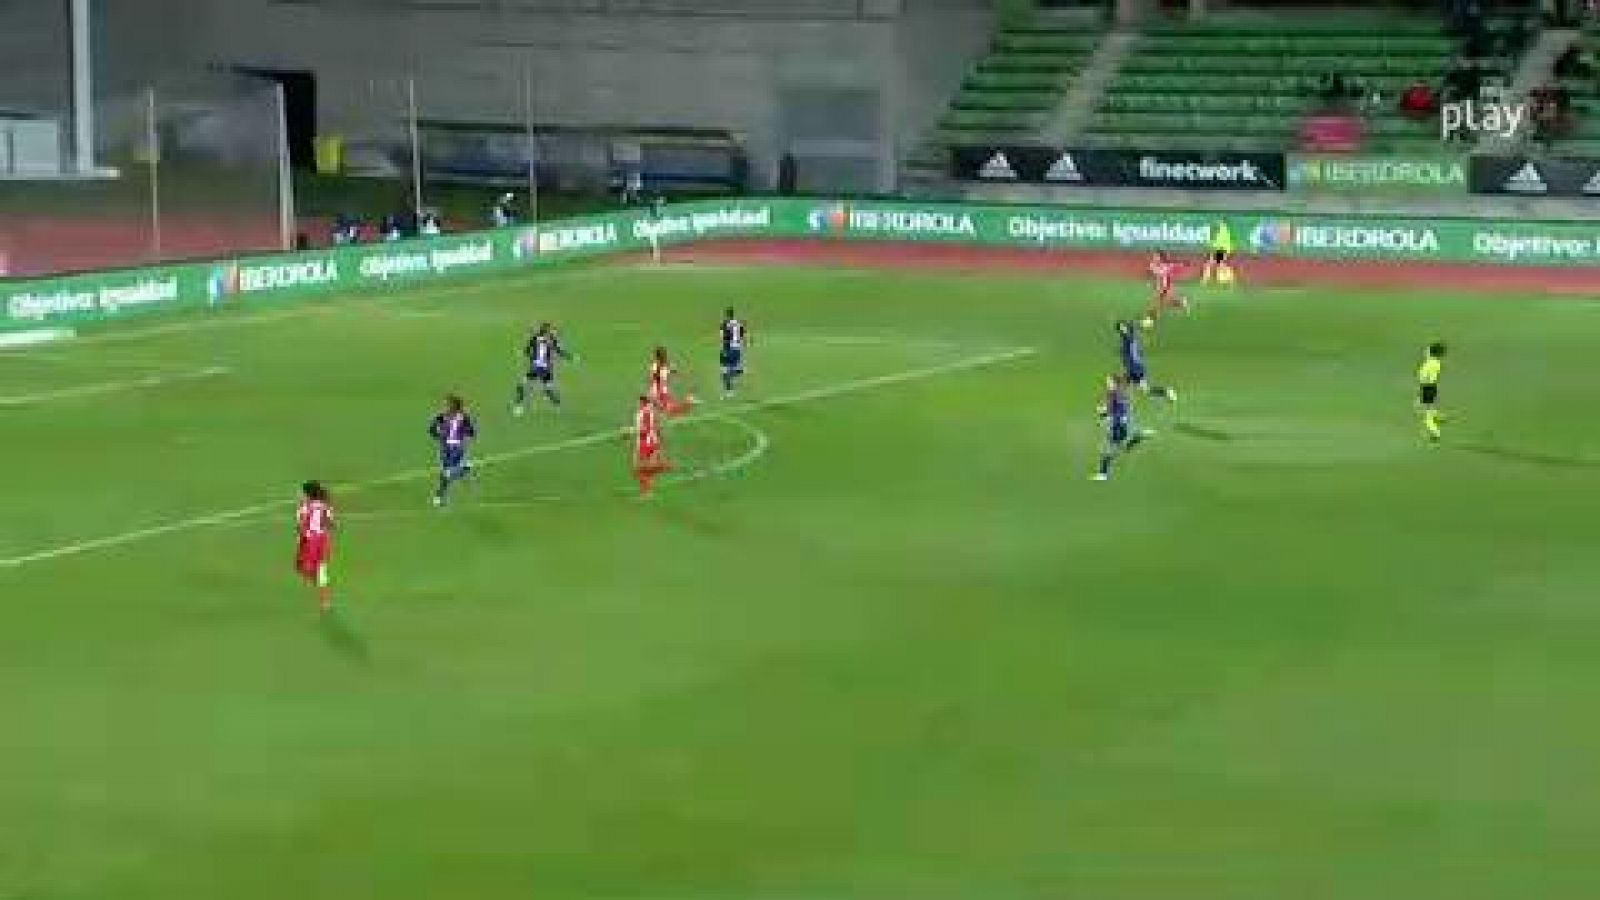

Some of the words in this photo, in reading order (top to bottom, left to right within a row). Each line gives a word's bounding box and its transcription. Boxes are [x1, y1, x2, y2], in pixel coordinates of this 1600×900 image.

[1139, 157, 1257, 182] finetwork
[849, 209, 975, 235] IBERDROLA
[1296, 225, 1440, 252] IBERDROLA
